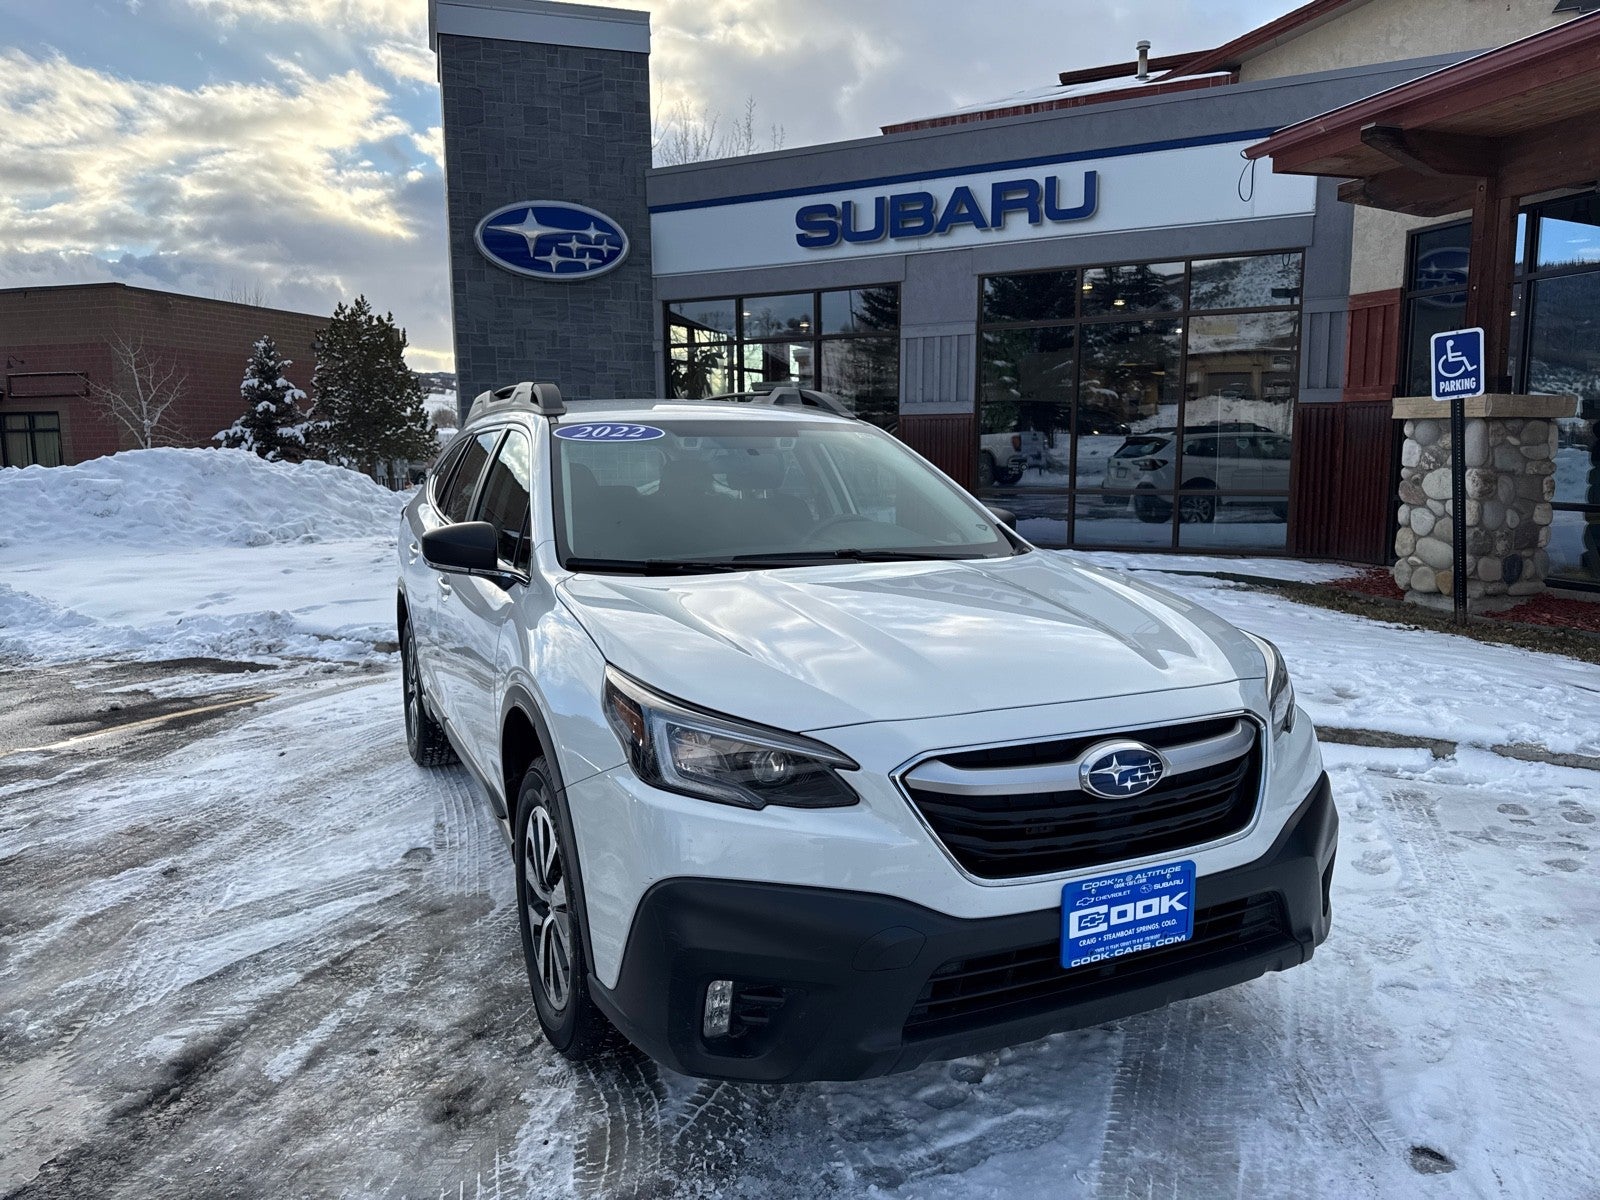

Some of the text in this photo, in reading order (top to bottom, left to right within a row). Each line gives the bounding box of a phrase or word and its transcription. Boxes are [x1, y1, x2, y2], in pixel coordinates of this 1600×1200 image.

[795, 170, 1098, 248] SUBARU
[1440, 377, 1476, 393] PARKING
[571, 425, 647, 438] 2022
[1134, 865, 1182, 880] ALTITUDE
[1153, 879, 1184, 890] SUBARU
[1095, 890, 1131, 902] CHEVROLET
[1069, 891, 1188, 939] COOK
[1078, 937, 1097, 947] CRAIG
[1103, 929, 1135, 942] STEAMBOAT
[1070, 934, 1187, 968] COOK-CARS.COM
